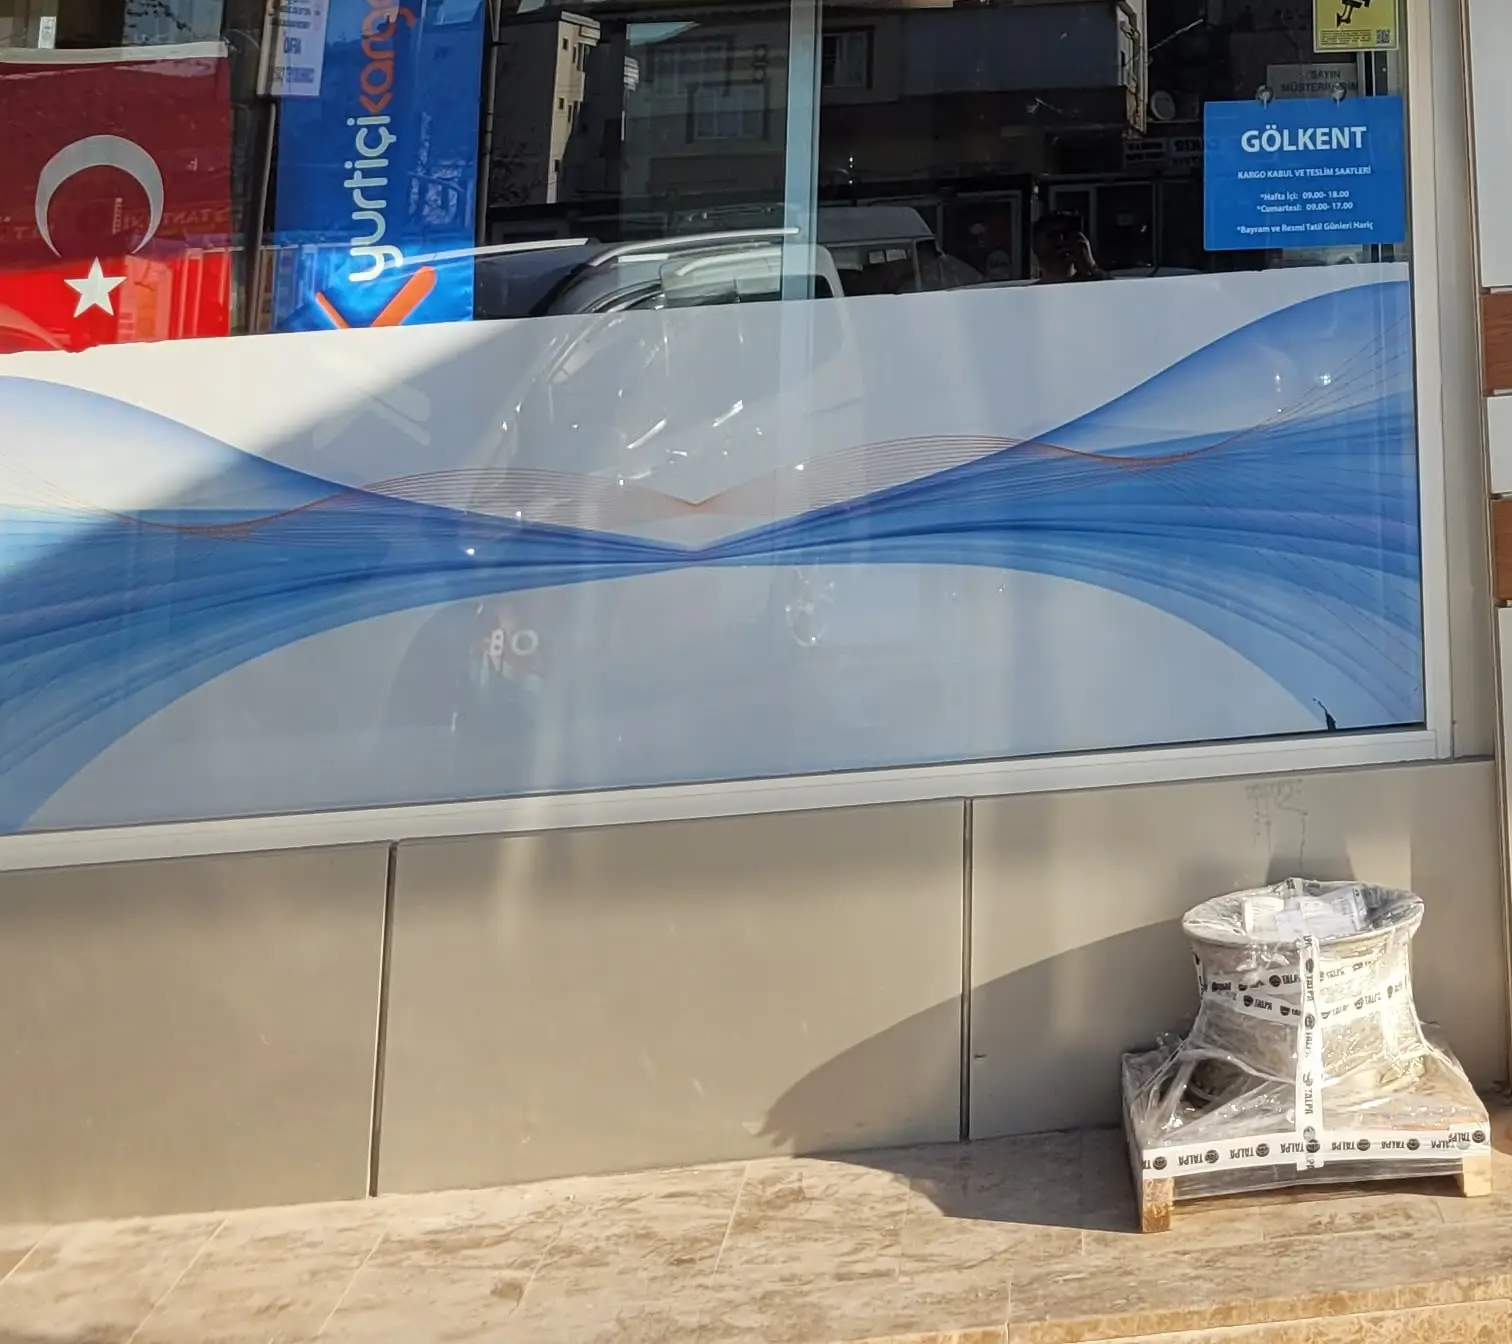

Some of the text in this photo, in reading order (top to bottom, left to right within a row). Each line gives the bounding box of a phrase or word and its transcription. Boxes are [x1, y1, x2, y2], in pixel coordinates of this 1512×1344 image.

[1240, 123, 1368, 153] GÖLKENT
[1237, 169, 1267, 180] KARGO
[1267, 168, 1294, 179] KABUL
[1294, 168, 1305, 178] VE
[1305, 166, 1334, 177] TESLİM
